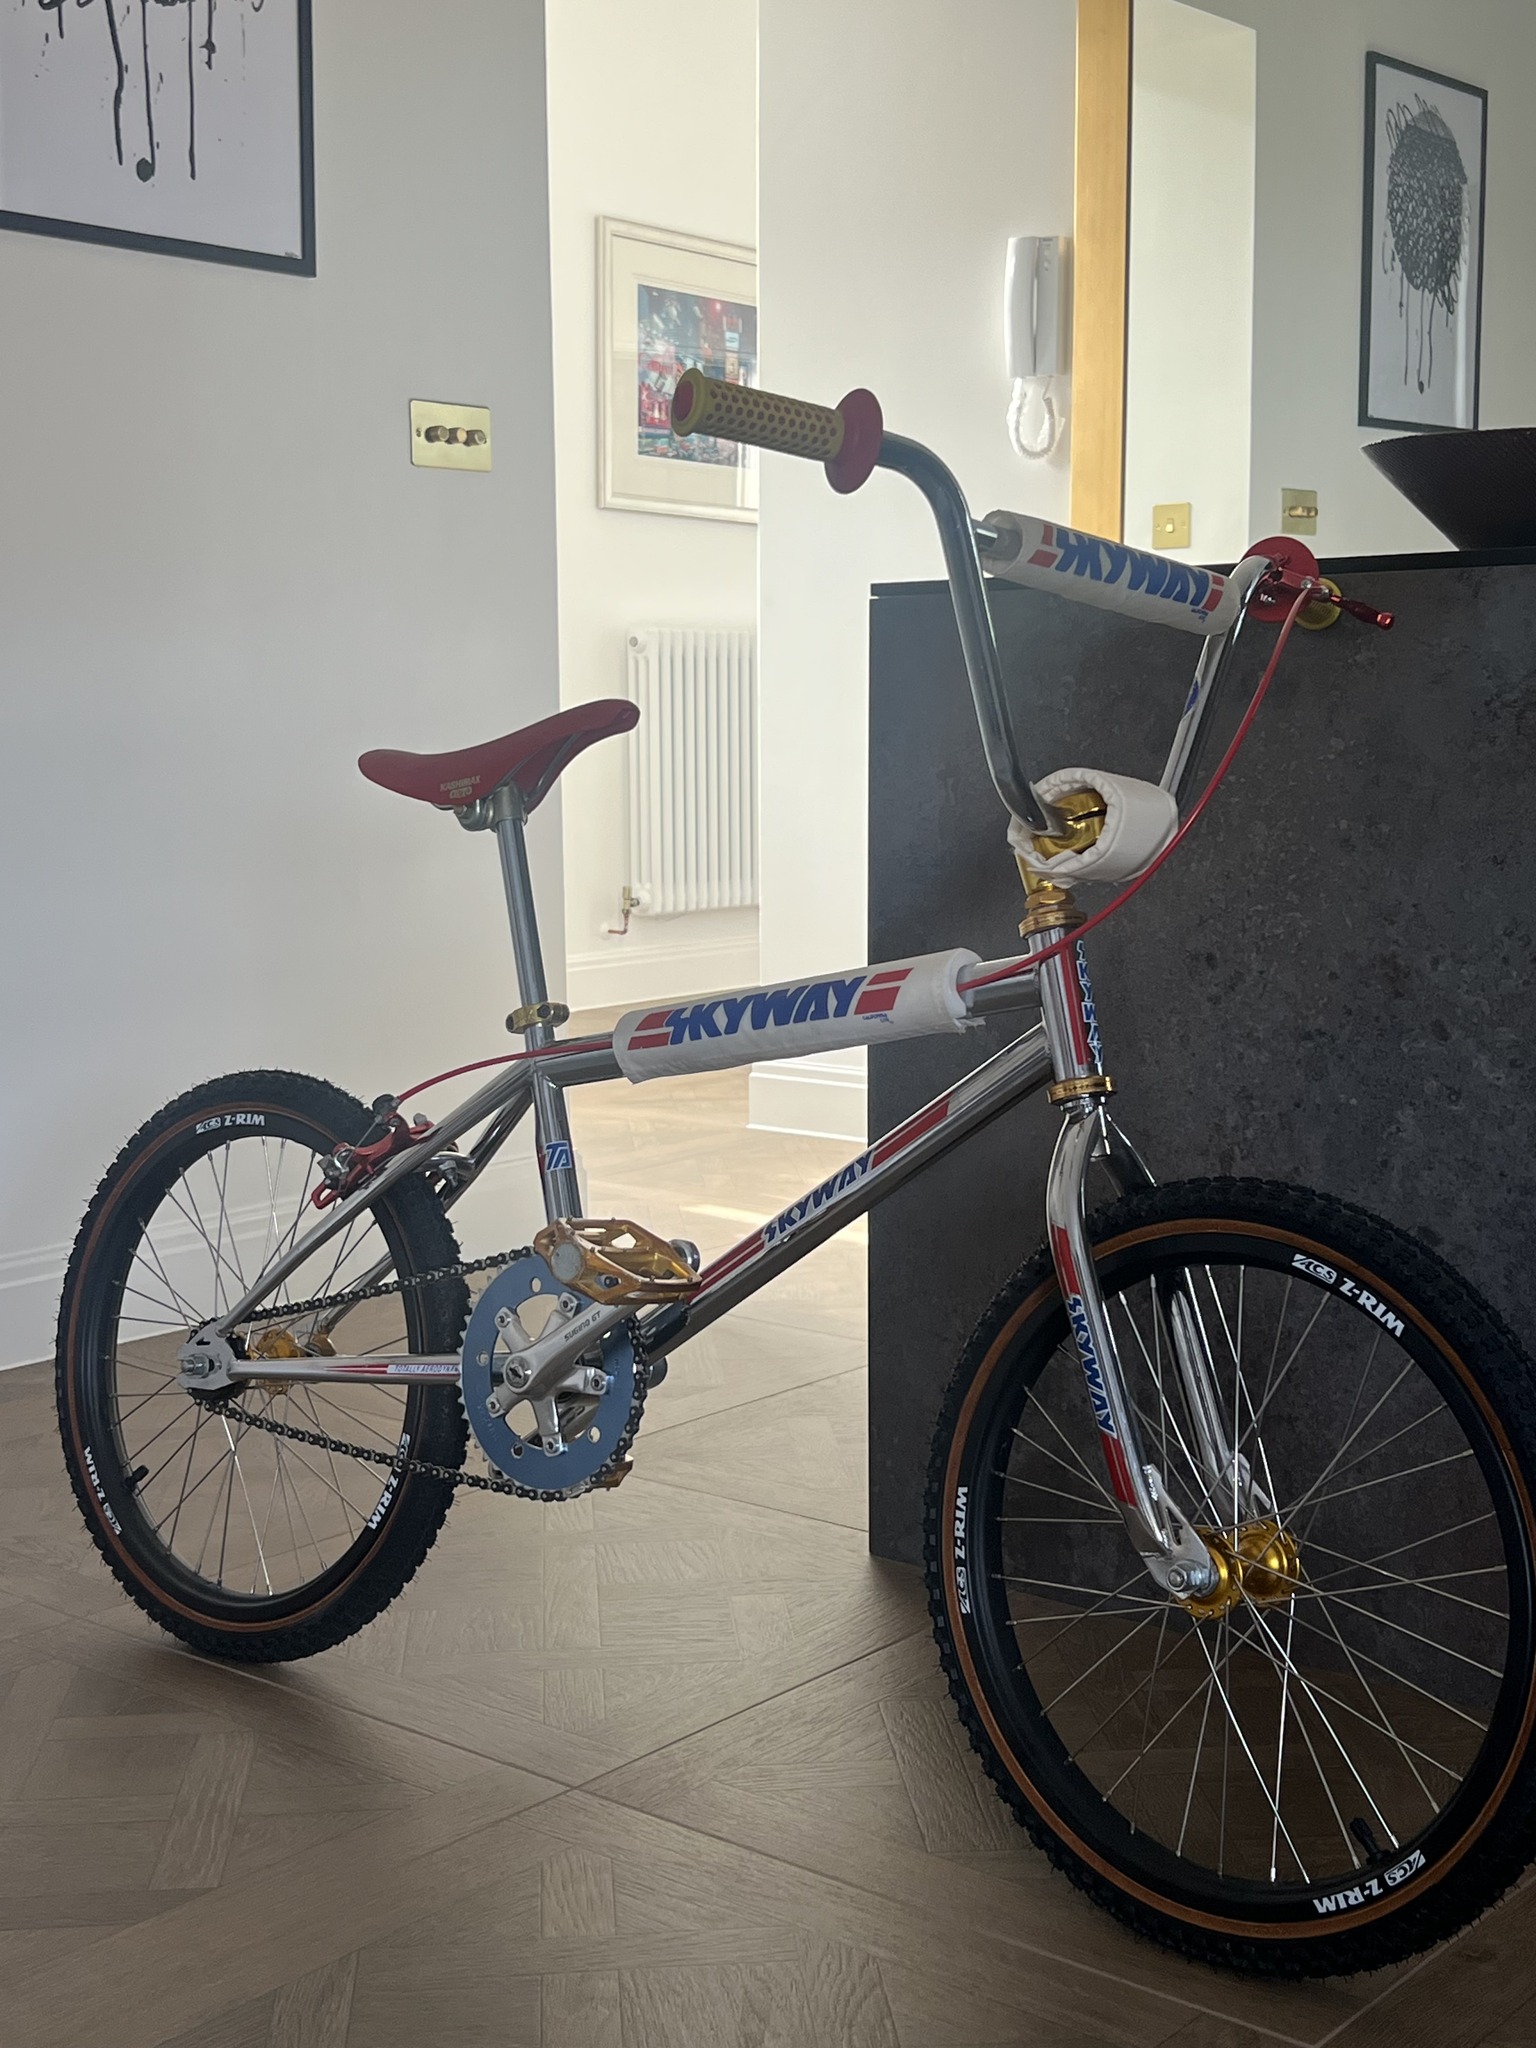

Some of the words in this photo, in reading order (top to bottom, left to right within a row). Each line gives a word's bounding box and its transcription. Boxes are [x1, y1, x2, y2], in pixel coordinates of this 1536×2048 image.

[1055, 527, 1212, 607] SKYWAY
[663, 975, 867, 1046] SKYWAY
[1076, 939, 1103, 1064] SKYWAY
[224, 1113, 265, 1127] Z-RIM
[763, 1149, 873, 1243] SKYWAY
[564, 1318, 591, 1343] SUGINO
[591, 1310, 602, 1322] GT
[1291, 1253, 1338, 1285] ACS
[1338, 1277, 1406, 1338] Z-RIM
[1066, 1294, 1117, 1439] SKYWAY
[366, 1475, 399, 1530] Z-RIM
[954, 1486, 969, 1560] Z-RIM
[1312, 1877, 1384, 1914] Z-RIM
[1383, 1849, 1427, 1887] ACS
